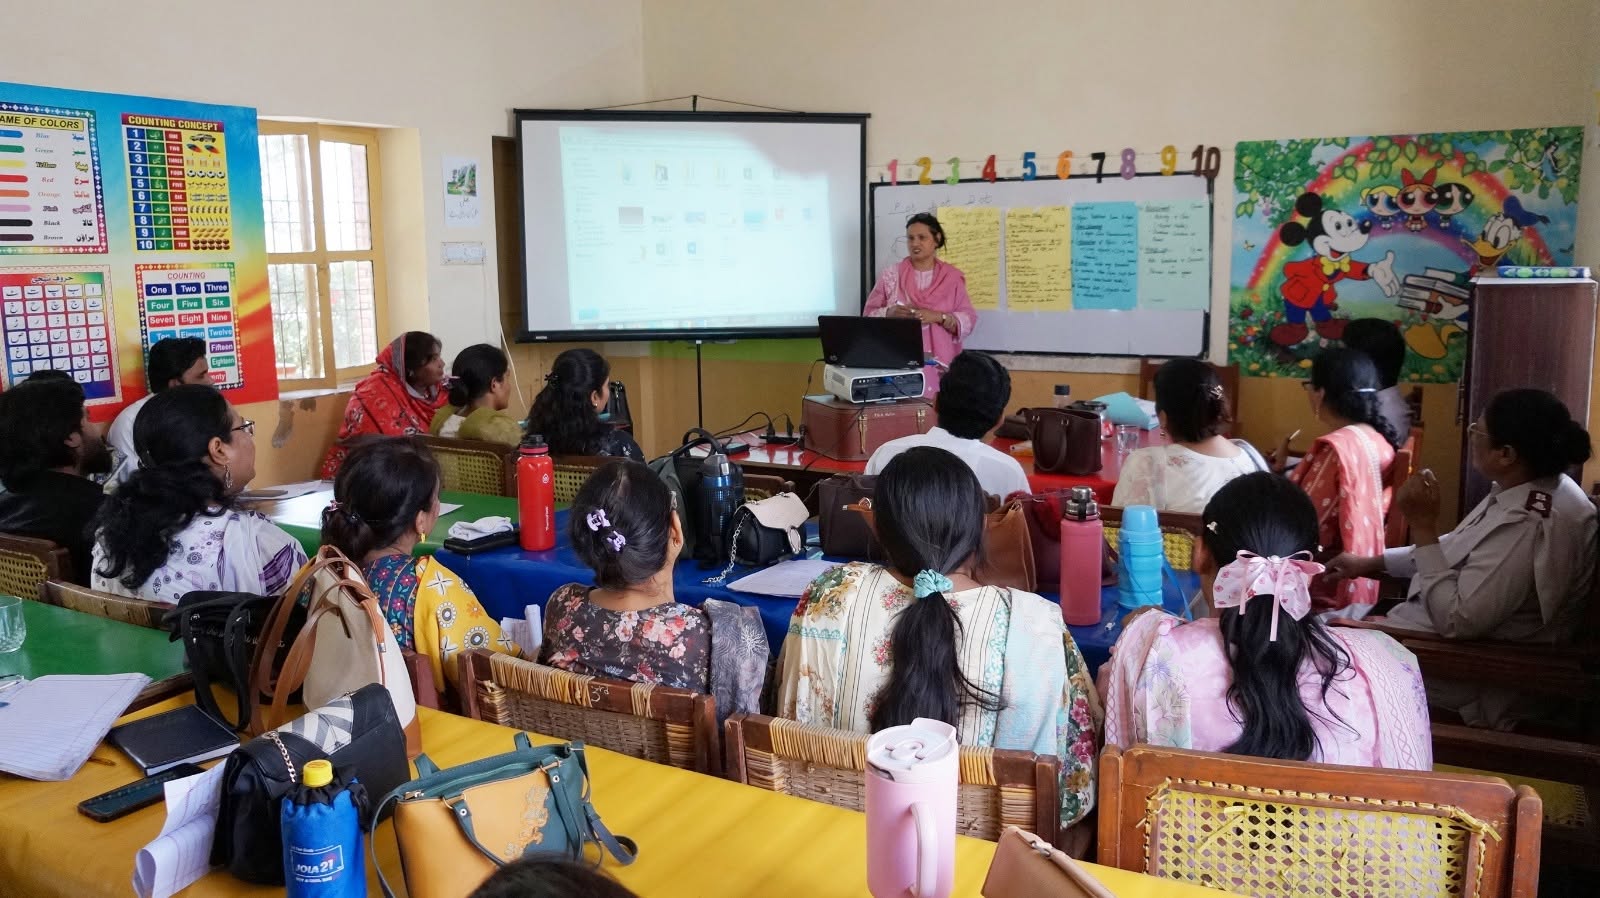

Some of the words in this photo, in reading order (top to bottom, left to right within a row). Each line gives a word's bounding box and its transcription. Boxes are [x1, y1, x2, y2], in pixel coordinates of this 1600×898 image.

[40, 119, 79, 129] COLORS
[128, 116, 175, 127] COUNTING
[178, 121, 218, 130] CONCEPT
[134, 142, 141, 150] 2
[135, 154, 142, 162] 3
[1023, 152, 1036, 180] 5
[1056, 150, 1073, 180] 6
[1091, 152, 1105, 183] 7
[1120, 148, 1136, 180] 8
[1160, 145, 1178, 176] 9
[1192, 145, 1221, 179] 10
[136, 167, 143, 175] 4
[888, 159, 898, 186] 1
[916, 157, 932, 185] 2
[946, 157, 960, 186] 3
[982, 155, 996, 183] 4
[140, 216, 147, 224] 8
[141, 229, 148, 237] 9
[182, 315, 200, 323] Eight
[212, 358, 234, 366] Eighteen
[320, 859, 333, 872] 21
